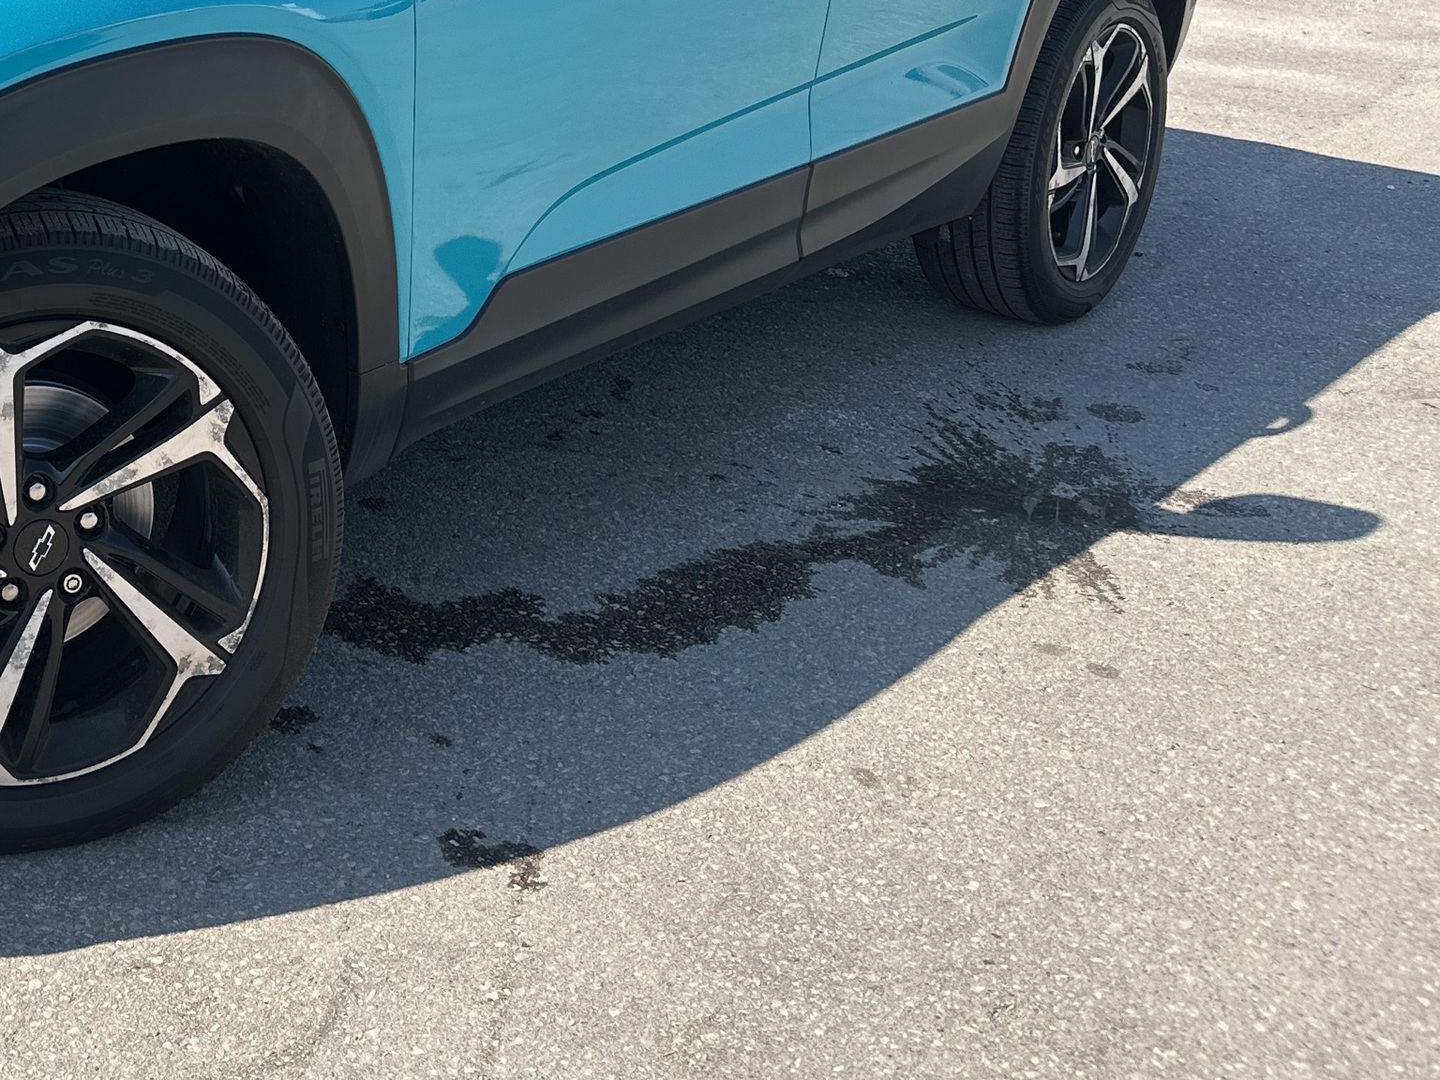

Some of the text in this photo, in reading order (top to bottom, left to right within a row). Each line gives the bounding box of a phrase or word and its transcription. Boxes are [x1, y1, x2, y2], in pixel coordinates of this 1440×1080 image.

[1, 256, 78, 282] AS
[87, 258, 127, 280] Plus
[131, 268, 156, 284] 3
